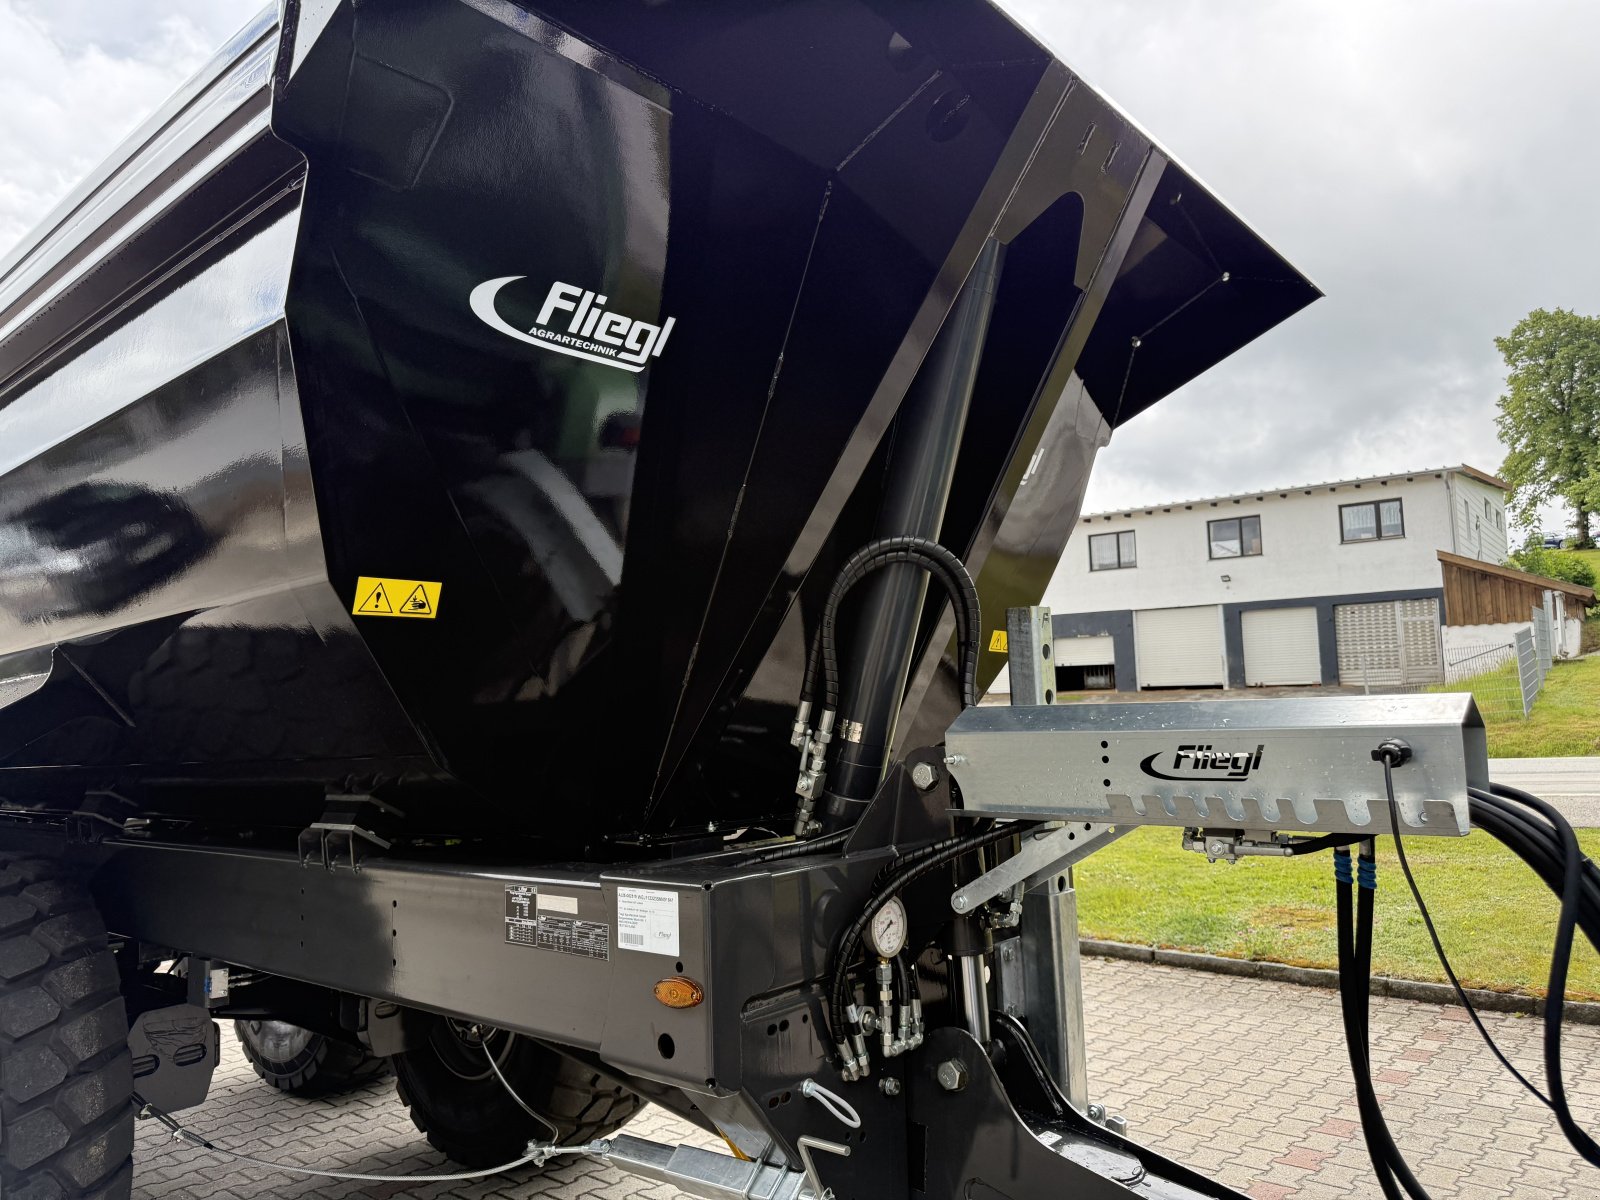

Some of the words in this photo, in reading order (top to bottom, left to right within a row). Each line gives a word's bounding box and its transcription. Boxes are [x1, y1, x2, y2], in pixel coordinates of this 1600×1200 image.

[535, 281, 677, 365] Fliegl
[528, 327, 618, 357] AGRARTECHNIK
[1173, 744, 1265, 777] Fliegl
